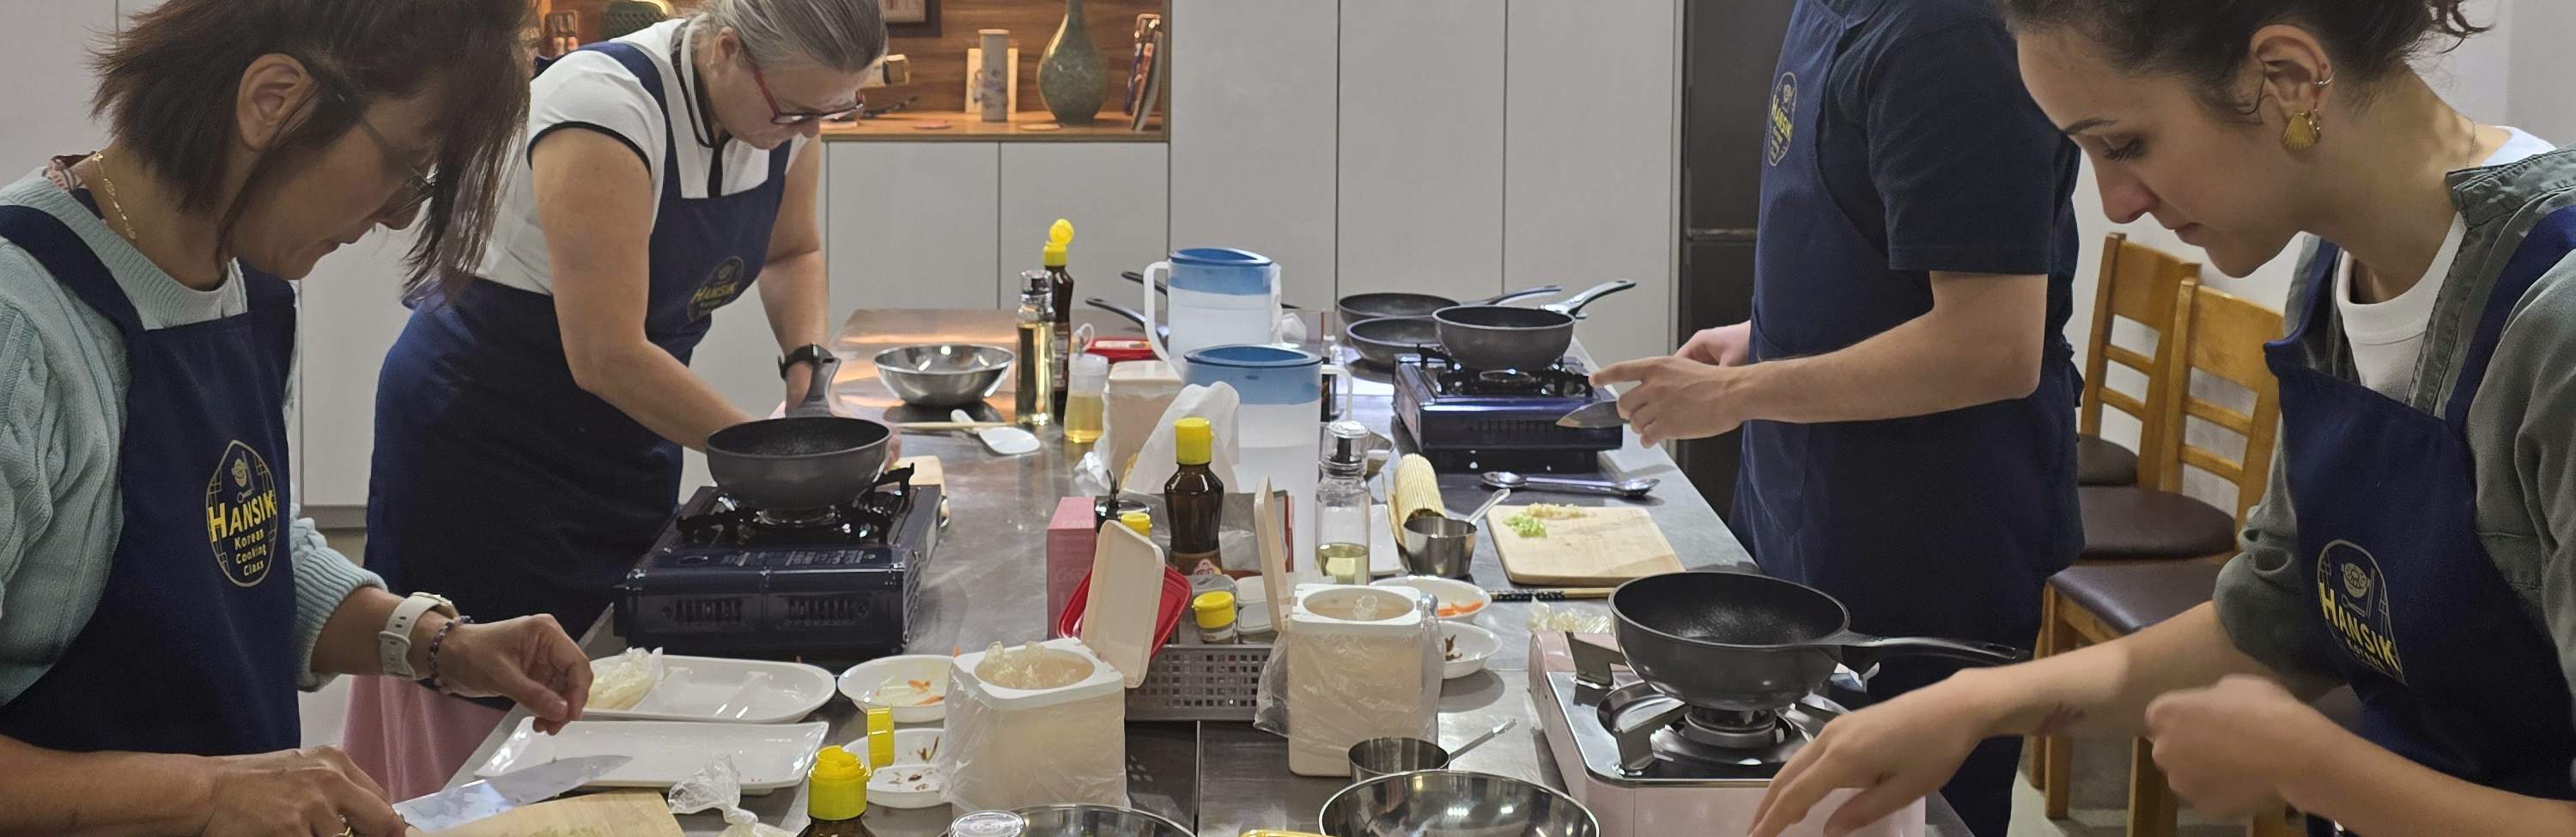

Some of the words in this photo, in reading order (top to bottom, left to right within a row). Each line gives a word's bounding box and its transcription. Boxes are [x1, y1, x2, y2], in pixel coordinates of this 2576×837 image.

[208, 489, 277, 543] HANSIK
[234, 529, 264, 550] Korean
[235, 544, 267, 565] Cooking
[243, 560, 264, 577] Class
[2319, 582, 2403, 672] HANSIK
